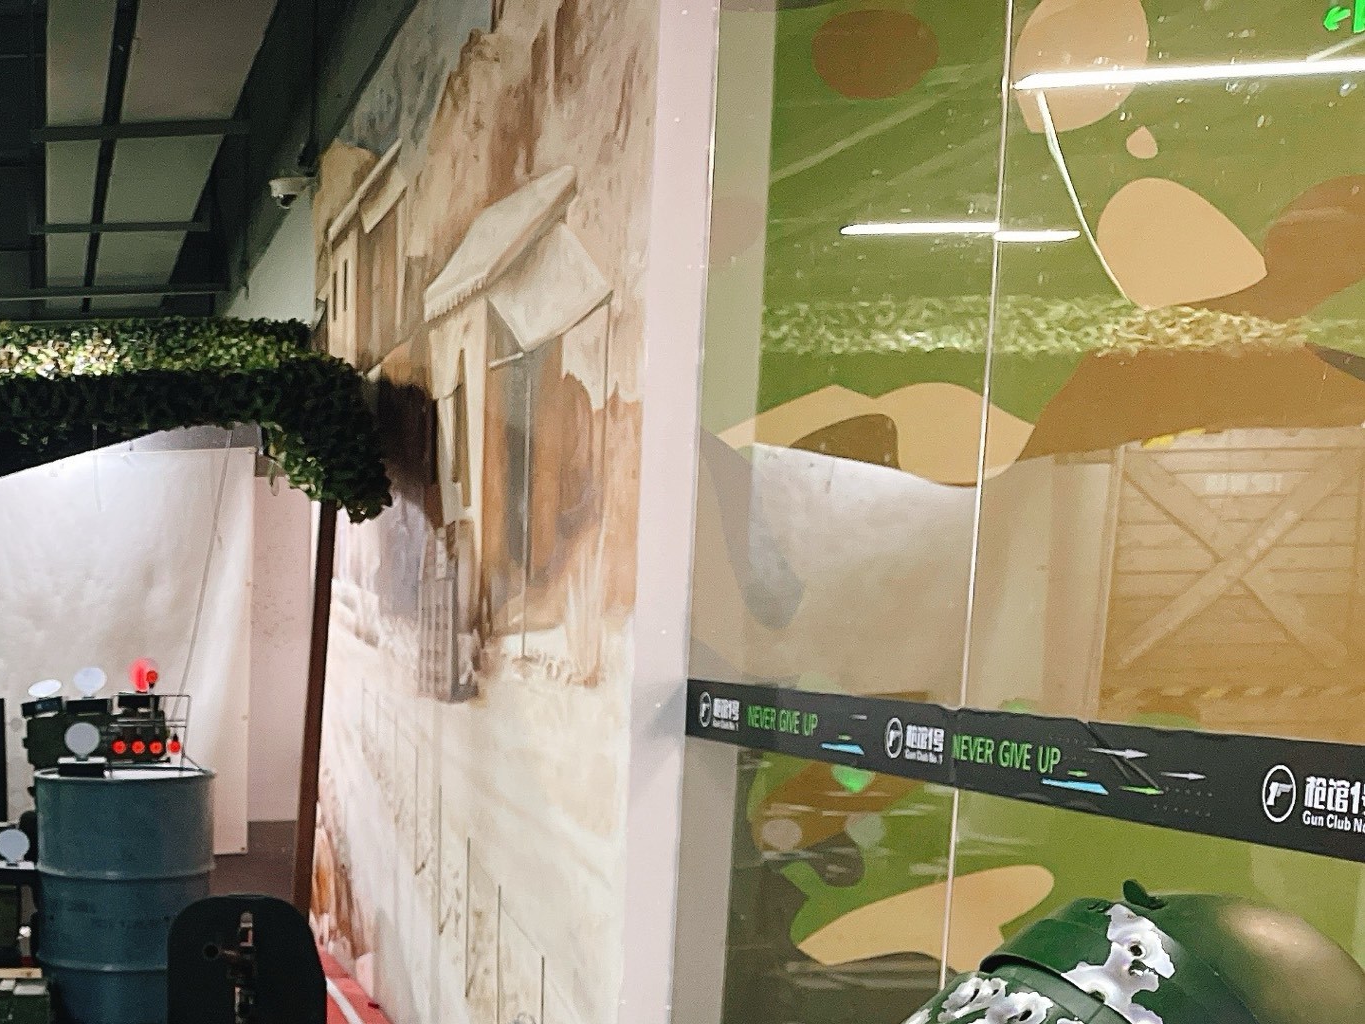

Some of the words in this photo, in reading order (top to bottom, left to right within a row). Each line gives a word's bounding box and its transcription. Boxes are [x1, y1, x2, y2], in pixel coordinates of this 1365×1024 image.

[746, 705, 776, 731] NEVER
[779, 709, 800, 735] GIVE
[802, 712, 818, 736] UP
[952, 734, 995, 765] NEVER
[998, 740, 1033, 771] GIVE
[1037, 746, 1061, 774] UP
[1304, 776, 1365, 816] 枪馆1
[1302, 810, 1324, 827] Gun
[1326, 813, 1351, 831] Club
